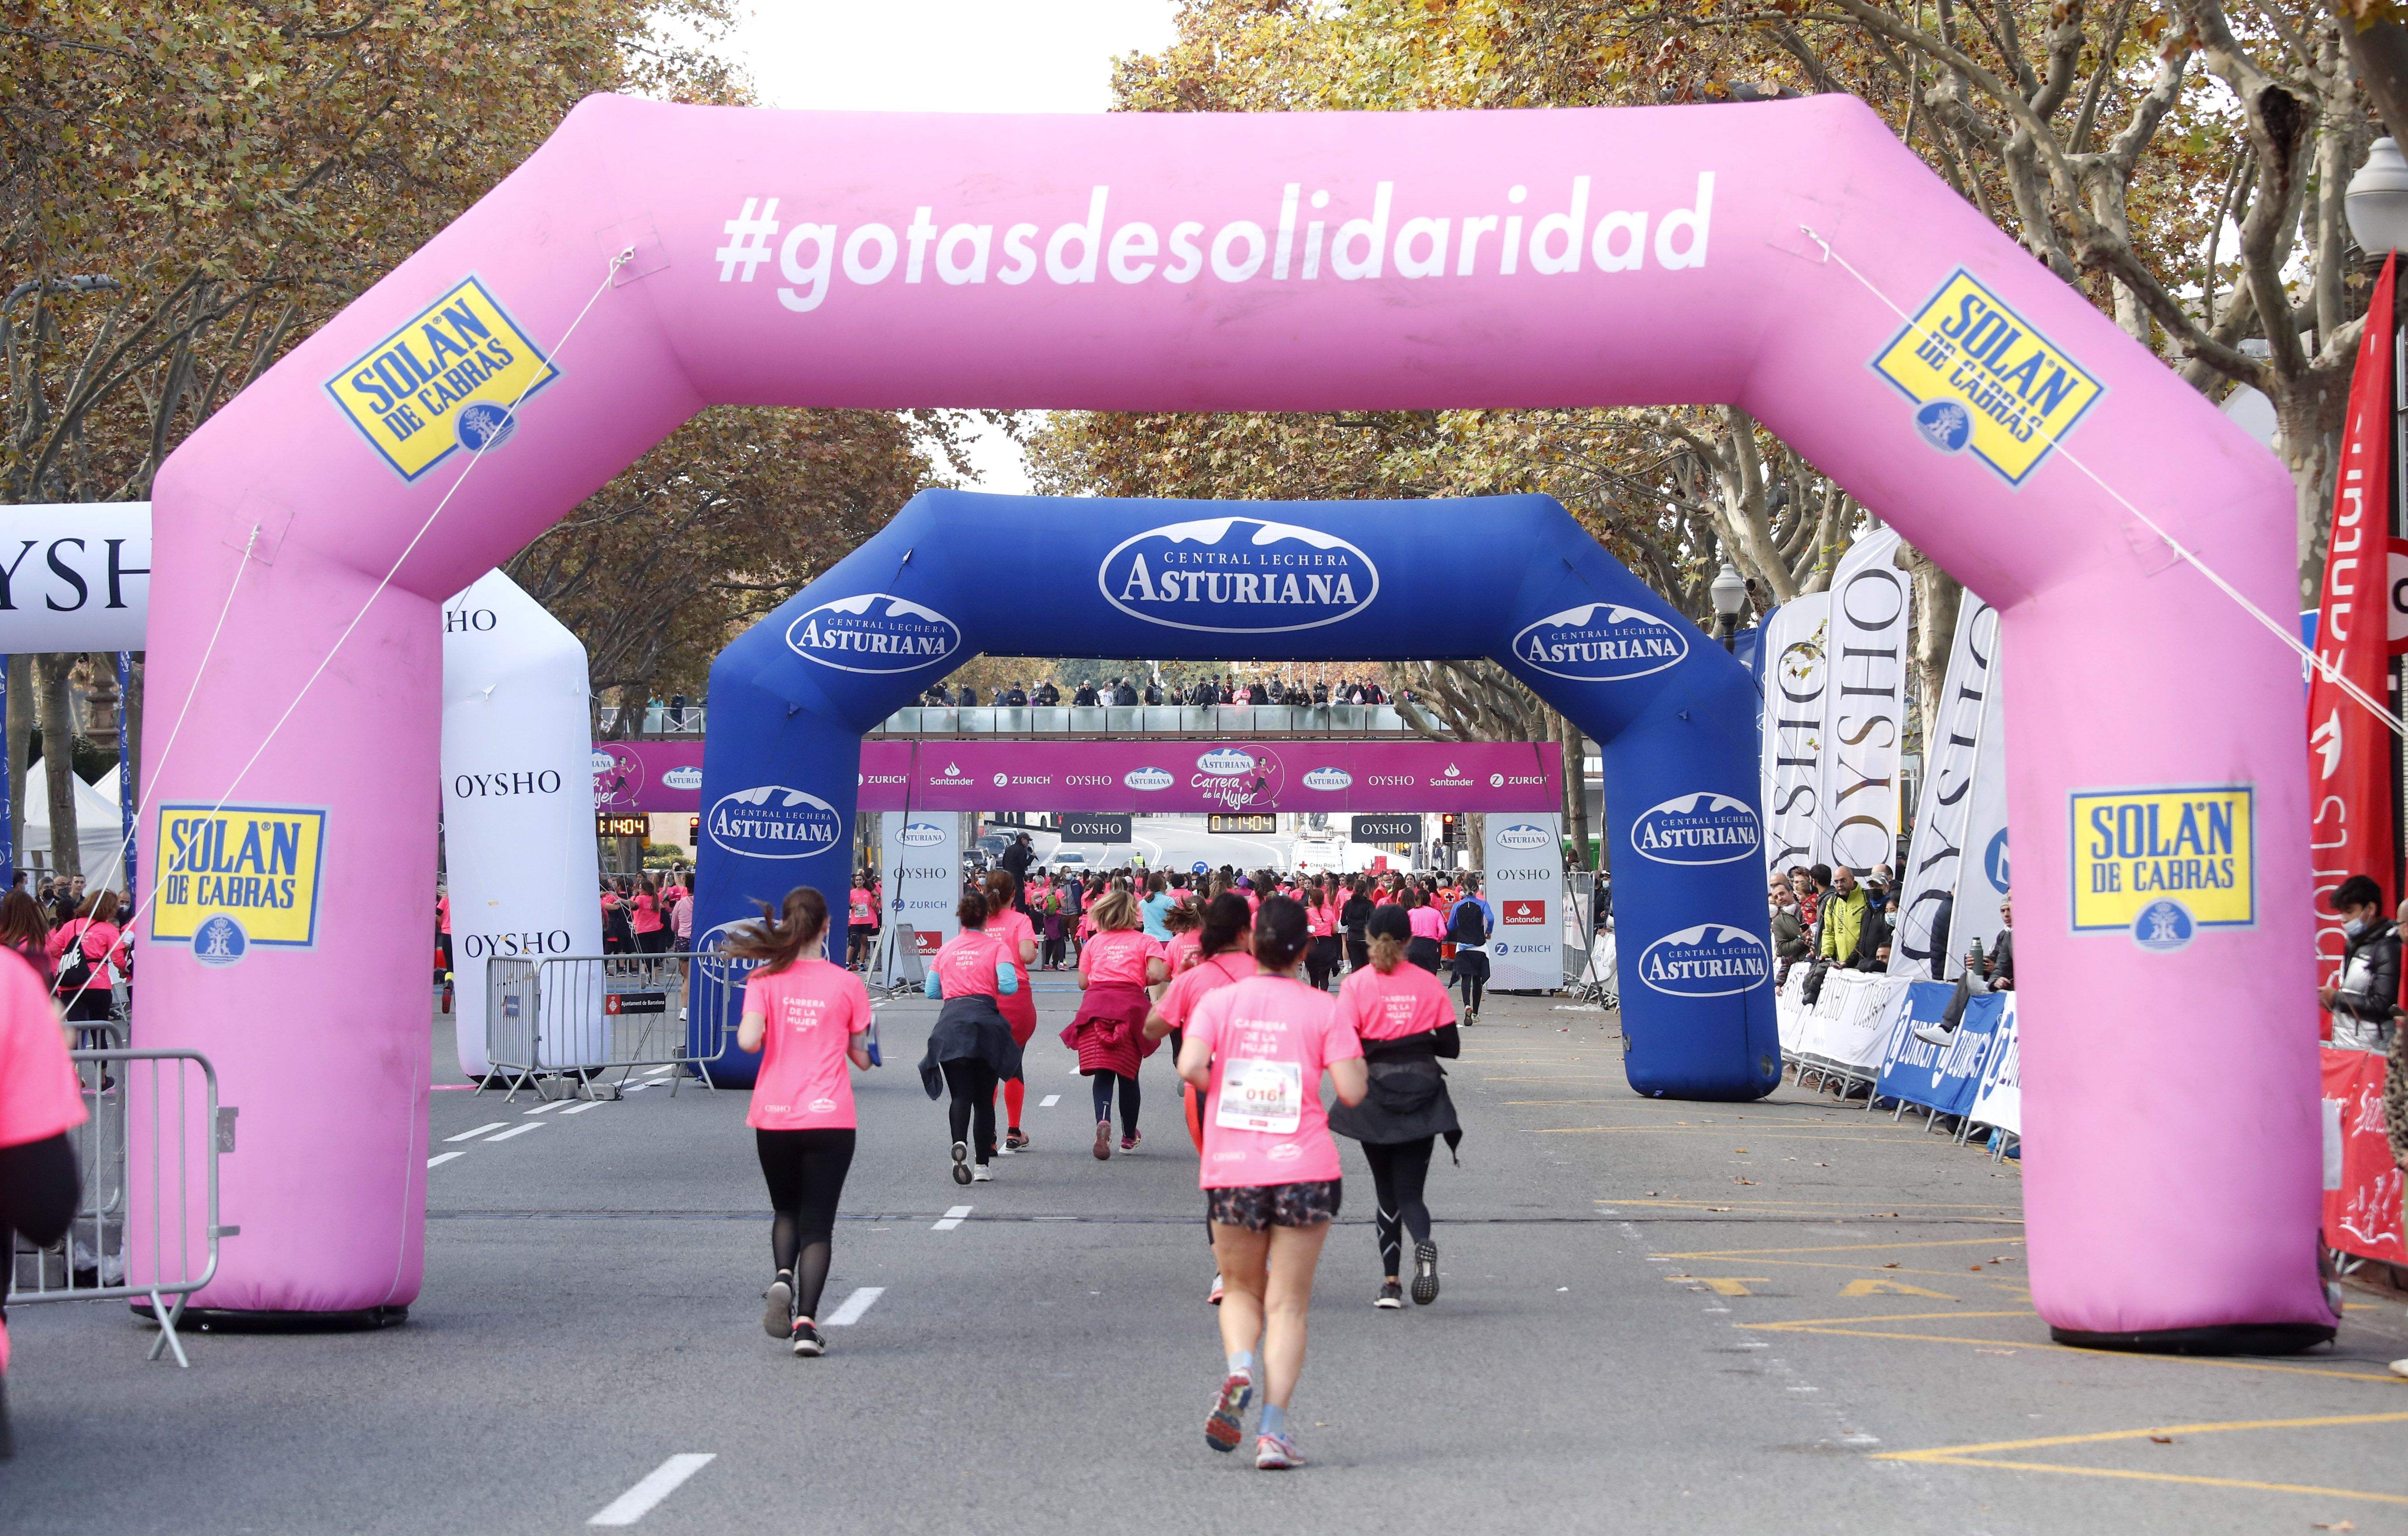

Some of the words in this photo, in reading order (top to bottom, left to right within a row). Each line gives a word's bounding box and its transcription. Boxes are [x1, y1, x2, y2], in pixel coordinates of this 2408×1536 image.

[715, 171, 1715, 312] #gotasdesolidaridad
[382, 403, 426, 441] DE
[418, 338, 514, 416] CABRAS
[1916, 331, 1956, 371] DE
[1949, 360, 2043, 443] CABRAS
[1164, 551, 1251, 565] CENTRAL
[1260, 554, 1348, 566] LECHERA
[0, 538, 152, 612] YSH
[1119, 553, 1358, 605] ASTURIANA
[447, 609, 496, 633] HO
[827, 618, 884, 629] CENTRAL
[889, 623, 945, 634] LECHERA
[797, 619, 946, 655] ASTURIANA
[1551, 629, 1609, 640] CENTRAL
[1615, 627, 1668, 636] LECHERA
[1527, 635, 1679, 663] ASTURIANA
[1832, 569, 1902, 877] OYSHO
[1201, 758, 1250, 768] ASTURIANA
[1768, 642, 1826, 870] YSHO
[455, 770, 561, 798] OYSHO
[666, 775, 702, 784] ASTURIAN
[930, 777, 974, 785] Santander
[1066, 775, 1112, 785] OYSHO
[1127, 776, 1171, 784] ASTURIANA
[1191, 773, 1240, 788] Carrera
[1306, 776, 1348, 785] ASTURIANA
[1368, 776, 1415, 786] OYSHO
[1430, 778, 1474, 786] Santander
[1508, 776, 1547, 784] ZURICH
[1203, 788, 1211, 799] de
[1214, 788, 1221, 799] la
[1219, 787, 1258, 810] Mujer
[734, 808, 783, 818] CENTRAL
[786, 810, 831, 821] LECHERA
[1661, 817, 1711, 827] CENTRAL
[1714, 815, 1753, 824] LECHERA
[599, 819, 645, 834] 1:14:04
[712, 807, 833, 843] ASTURIANA
[1071, 823, 1122, 834] OYSHO
[1212, 816, 1272, 831] 01:14:04
[1361, 823, 1412, 835] OYSHO
[899, 833, 943, 841] ASTURIANA
[1500, 833, 1546, 843] ASTURIANA
[1641, 821, 1757, 850] ASTURIANA
[894, 868, 947, 879] OYSHO
[1497, 869, 1550, 880] OYSHO
[2091, 862, 2121, 893] DE
[2134, 858, 2234, 891] CABRAS
[166, 875, 189, 905] DE
[198, 875, 295, 909] CABRAS
[465, 930, 570, 958] OYSHO
[1669, 948, 1718, 958] CENTRAL
[1648, 953, 1765, 981] ASTURIANA
[782, 996, 826, 1008] CARRERA
[789, 1007, 802, 1015] DE
[786, 1016, 817, 1026] MUJER
[1233, 1018, 1288, 1031] CARRERA
